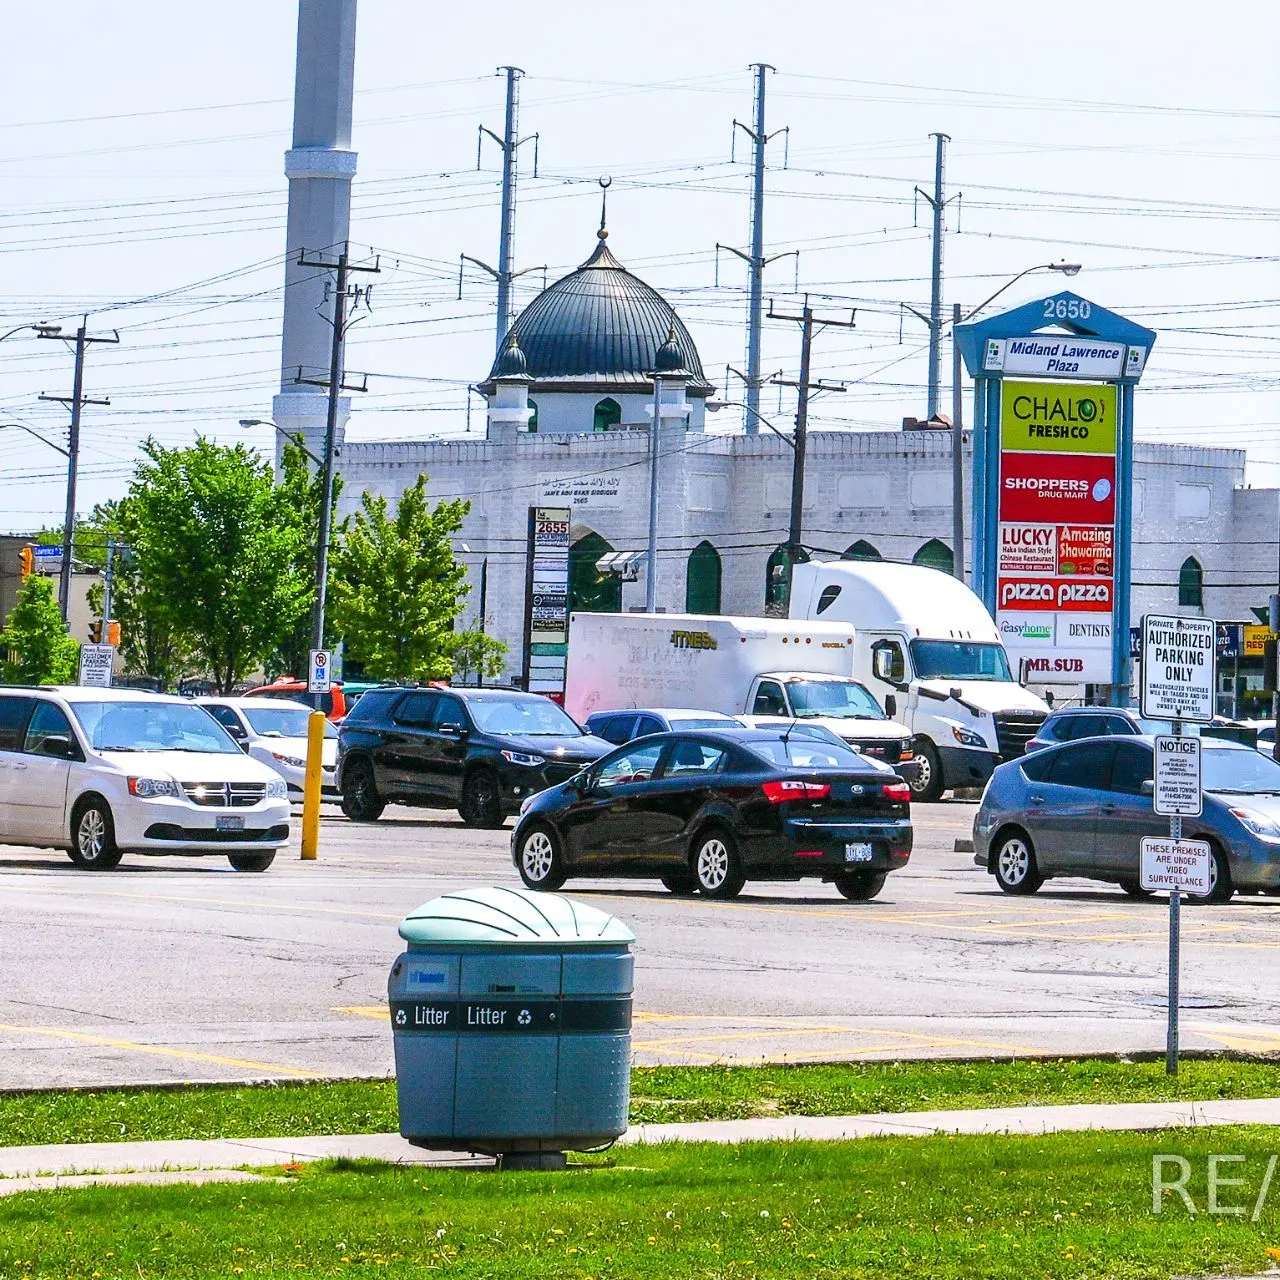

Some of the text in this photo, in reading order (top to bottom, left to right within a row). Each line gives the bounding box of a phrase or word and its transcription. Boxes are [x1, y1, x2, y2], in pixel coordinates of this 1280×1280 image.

[1043, 299, 1091, 319] 2650
[1010, 342, 1119, 359] Midland Lawrence
[1046, 358, 1079, 372] Plaza
[1013, 396, 1106, 423] CHALO!
[1005, 478, 1089, 491] SHOPPERS
[1038, 490, 1062, 498] DRUG
[538, 523, 567, 534] 2655
[1060, 526, 1111, 544] Amazing
[1002, 528, 1053, 546] LUCKY
[1038, 547, 1052, 555] Style
[1060, 543, 1112, 558] Shawarma
[1000, 554, 1054, 563] Chinese Restaurant
[1002, 584, 1109, 606] pizza pizza
[1069, 624, 1110, 638] DENTISTS
[1149, 620, 1211, 631] PRIVATE PROPERTY
[1149, 630, 1211, 648] AUTHORIZED
[1155, 648, 1204, 666] PARKING
[1028, 658, 1083, 672] MR.SUB
[1166, 666, 1193, 682] ONLY
[1160, 741, 1196, 752] NOTICE
[1146, 844, 1206, 857] THESE PREMISES
[1156, 855, 1197, 866] ARE UNDER
[1166, 866, 1188, 874] VIDEO
[1148, 875, 1203, 886] SURVEILLANCE
[415, 1006, 507, 1024] Litter Litter
